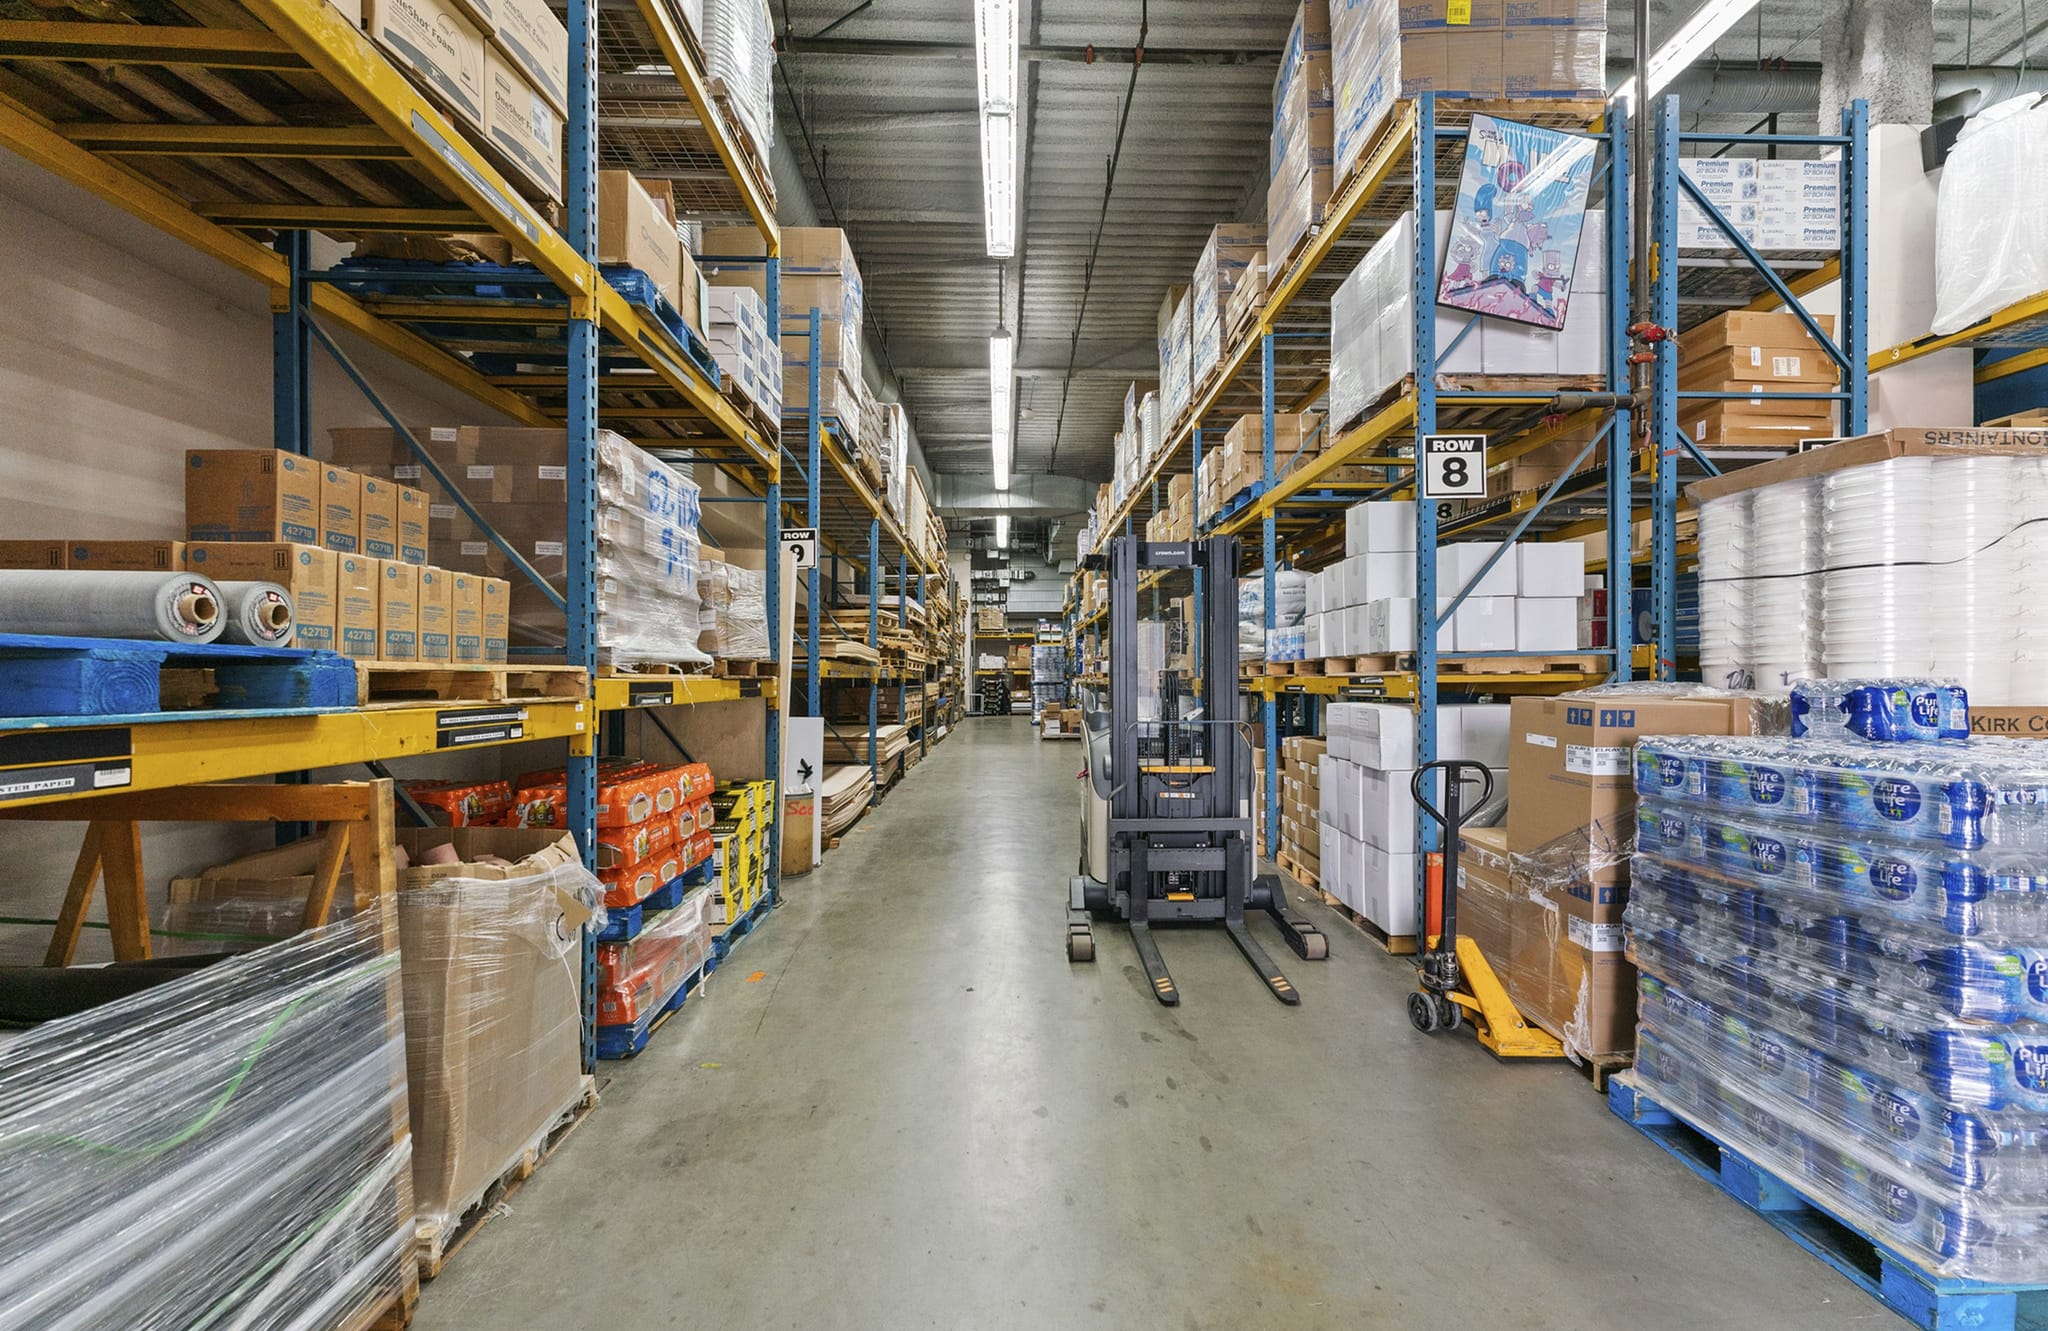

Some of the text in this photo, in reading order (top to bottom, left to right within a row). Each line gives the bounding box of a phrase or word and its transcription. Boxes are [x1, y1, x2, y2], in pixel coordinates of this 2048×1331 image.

[432, 28, 456, 56] Foam
[495, 91, 526, 124] OneShot
[1892, 349, 1900, 360] 3
[1433, 440, 1474, 451] ROW
[1442, 457, 1468, 487] 8
[1515, 498, 1521, 508] 3
[1437, 503, 1452, 518] 8
[286, 526, 312, 538] 42718
[330, 535, 352, 545] 42718
[370, 542, 391, 553] 42718
[404, 548, 424, 557] 42718
[790, 544, 804, 562] 9
[301, 627, 329, 638] 42718
[347, 630, 372, 640] 42718
[390, 632, 412, 643] 42718
[426, 635, 447, 645] 42718
[459, 638, 478, 646] 42718
[487, 640, 504, 648] 42718
[1916, 697, 1936, 706] Pur
[35, 780, 72, 789] PAPER
[1880, 781, 1911, 794] Pure
[1882, 792, 1905, 807] Life
[1878, 859, 1907, 874] Pure
[1880, 870, 1901, 886] Life
[1879, 1092, 1910, 1116] Pure
[1942, 1109, 1952, 1120] 24
